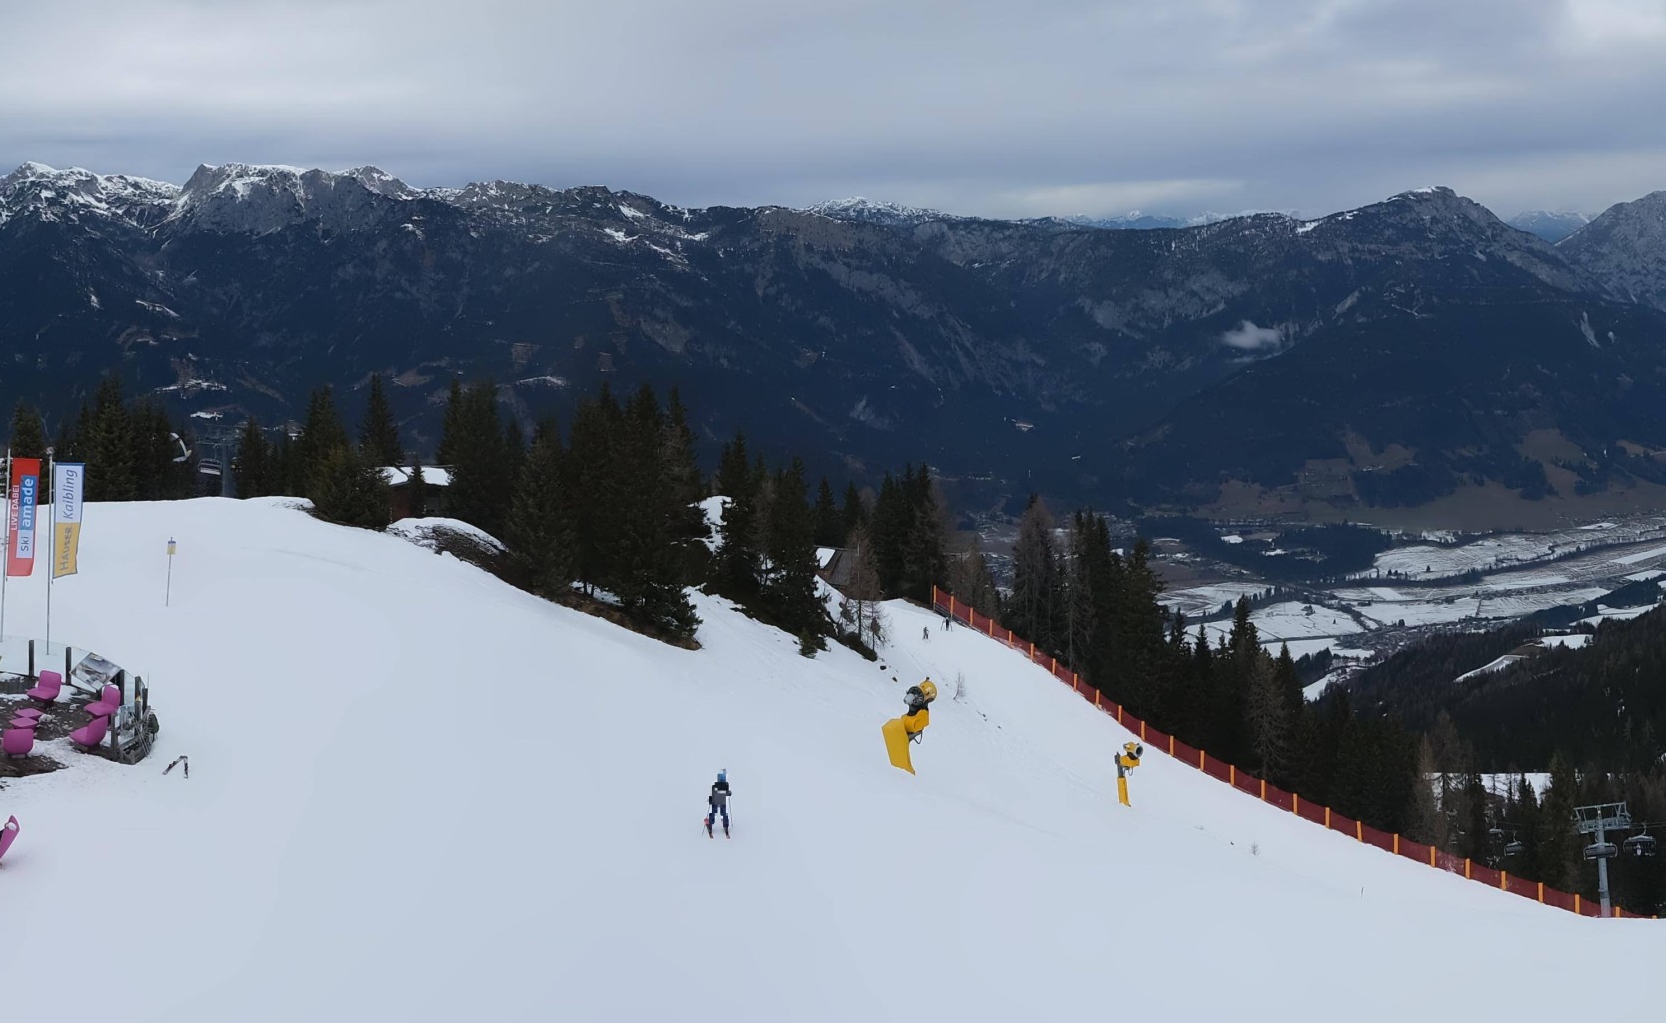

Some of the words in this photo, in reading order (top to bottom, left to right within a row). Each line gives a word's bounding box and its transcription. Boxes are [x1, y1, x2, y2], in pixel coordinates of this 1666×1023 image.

[12, 484, 20, 510] DABEI
[63, 469, 78, 520] Kaibling
[10, 512, 19, 531] LIVE
[20, 536, 30, 552] Ski
[60, 527, 72, 571] HAUSER
